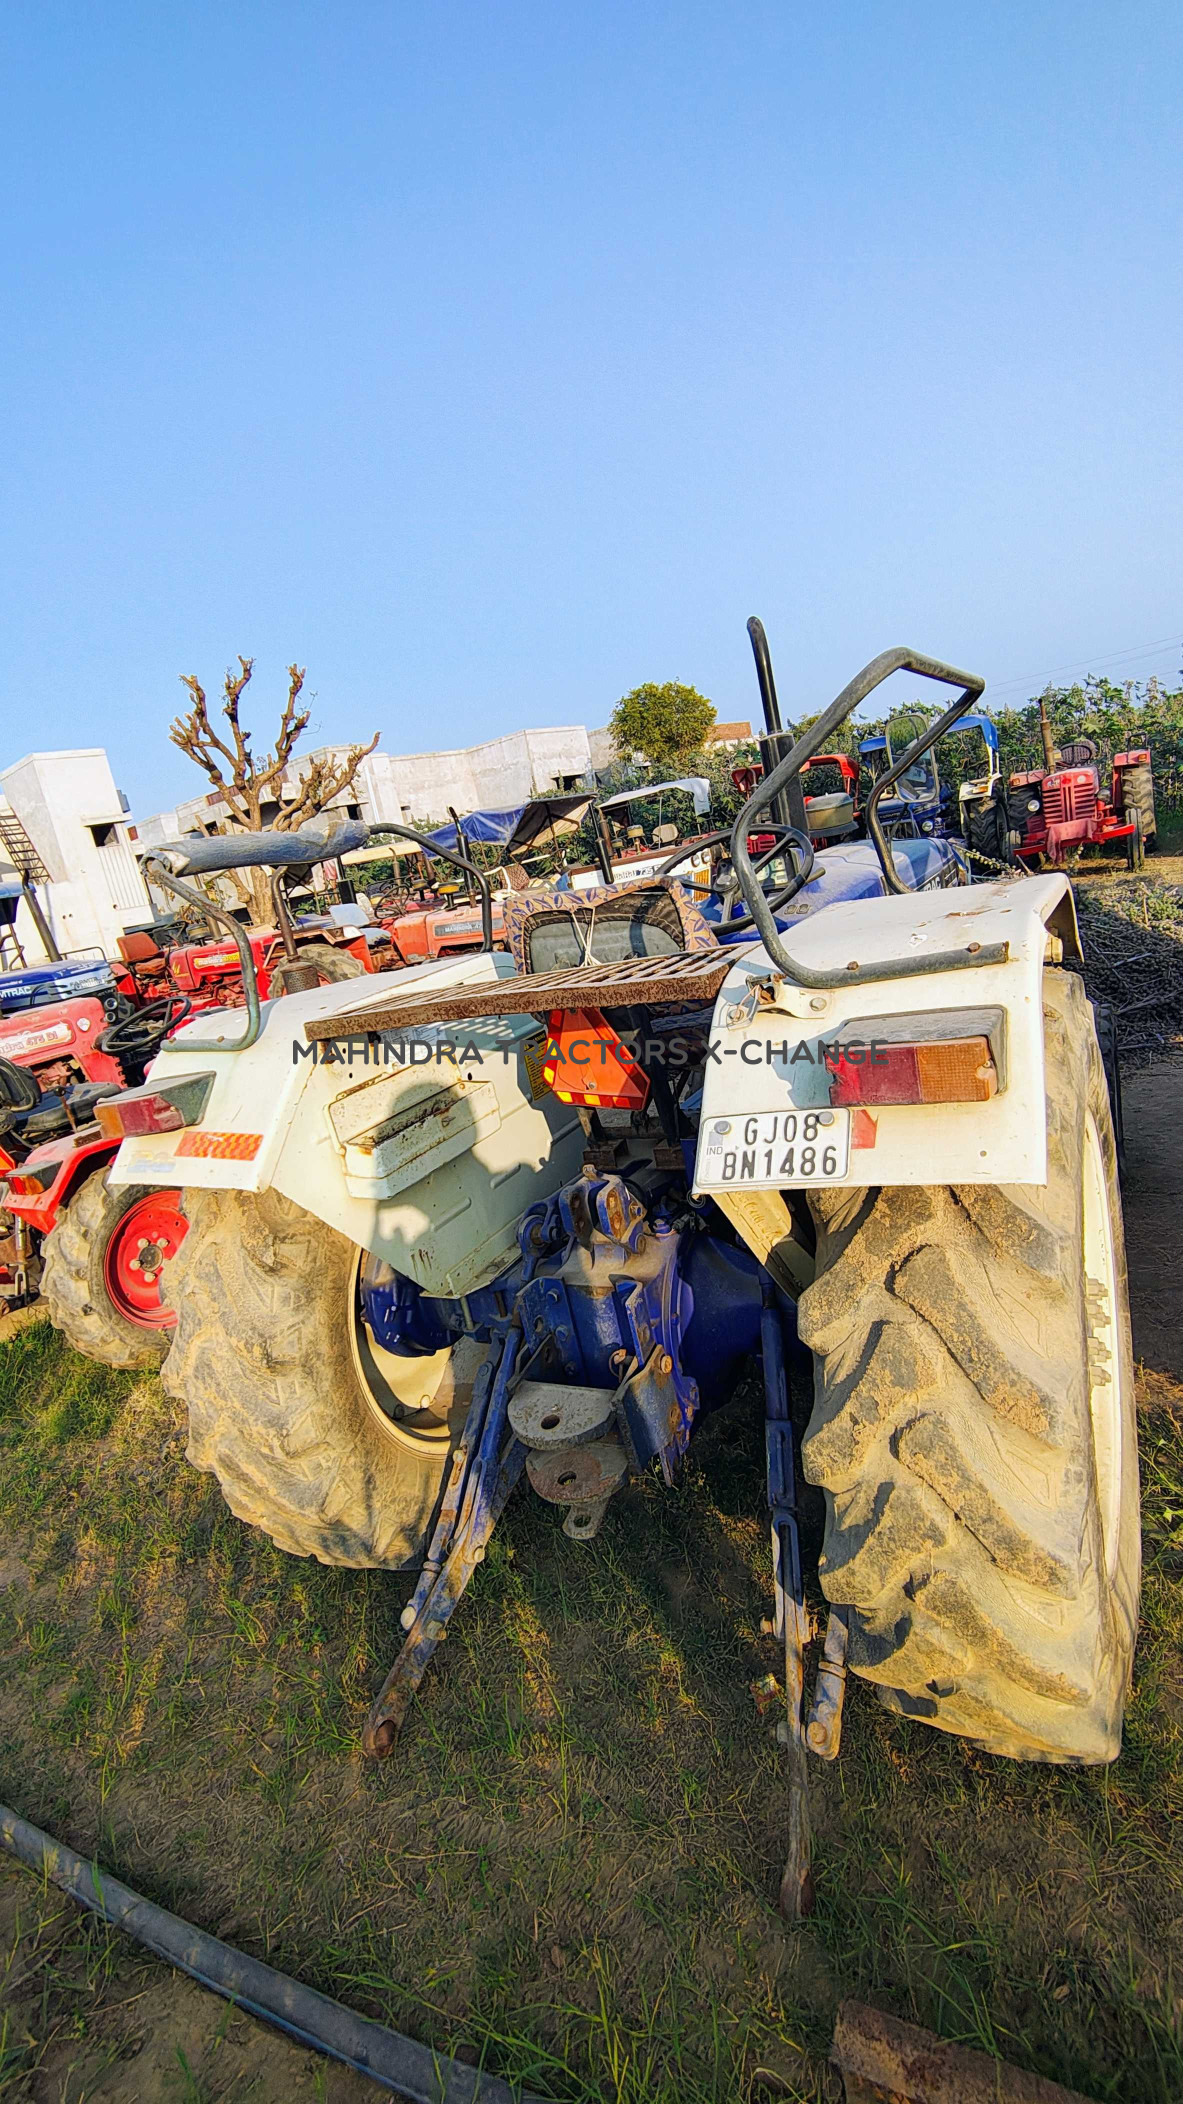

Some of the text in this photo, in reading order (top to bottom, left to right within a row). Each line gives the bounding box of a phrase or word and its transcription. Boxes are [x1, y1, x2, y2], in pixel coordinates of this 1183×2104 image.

[744, 1112, 819, 1146] GJ08
[706, 1146, 723, 1155] IND
[722, 1145, 837, 1181] BN1486
